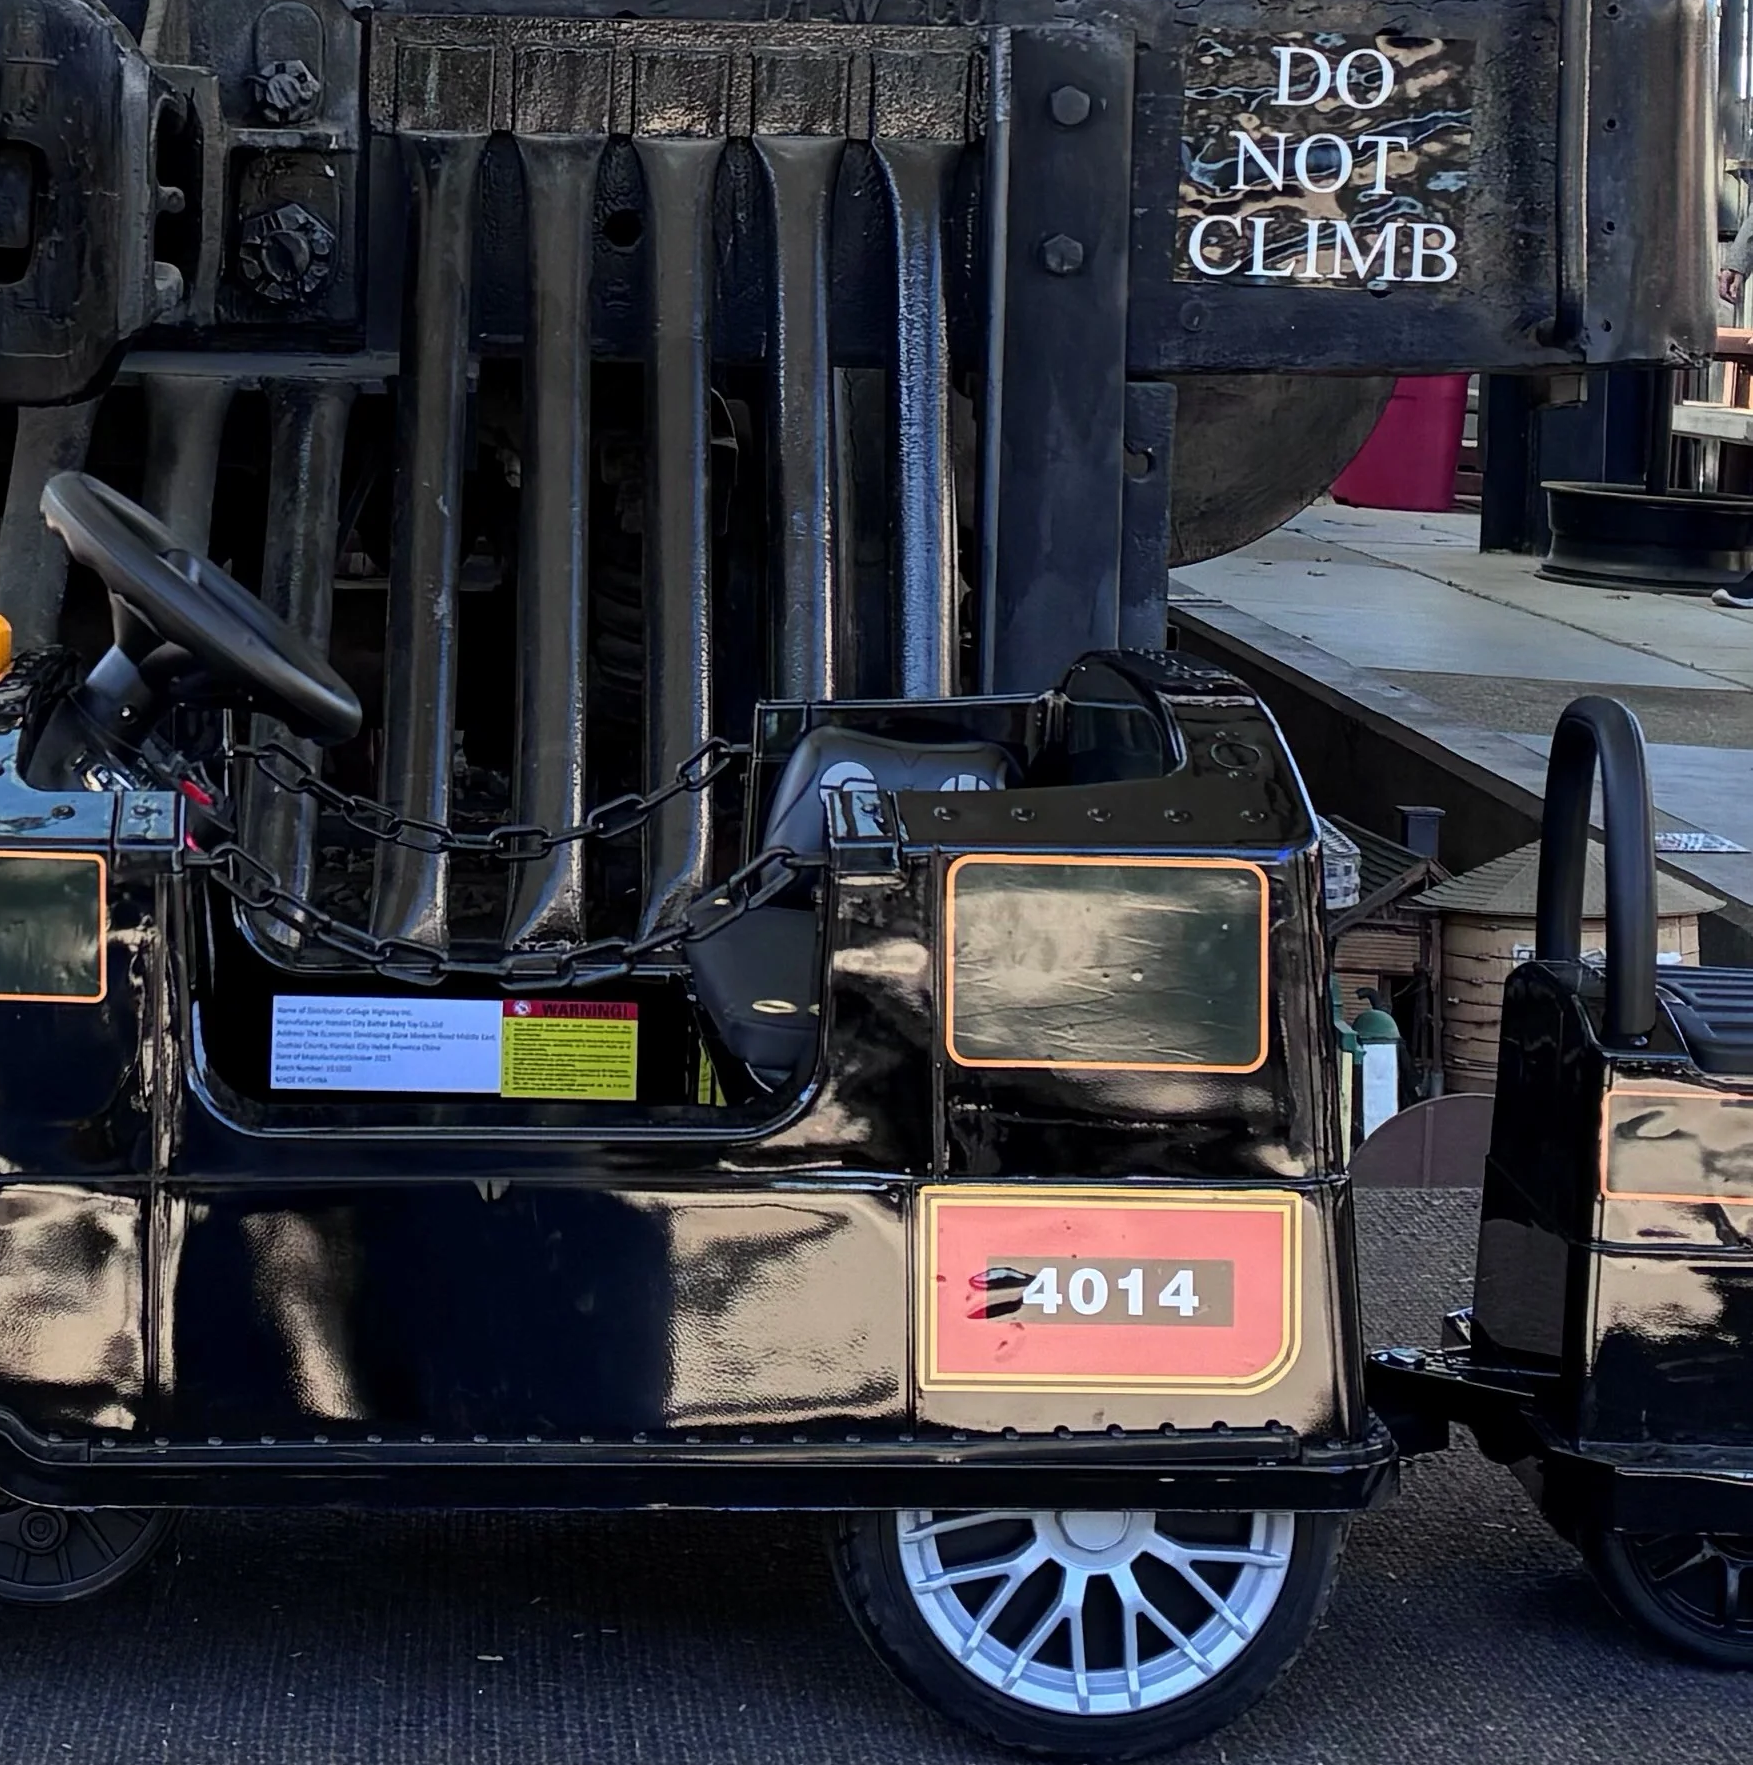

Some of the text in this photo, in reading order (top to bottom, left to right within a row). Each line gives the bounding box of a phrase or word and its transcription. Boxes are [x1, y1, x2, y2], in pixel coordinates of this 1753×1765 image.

[1270, 46, 1394, 109] DO
[1229, 130, 1408, 195] NOT
[1188, 214, 1458, 283] CLIMB
[1022, 1266, 1200, 1317] 4014
